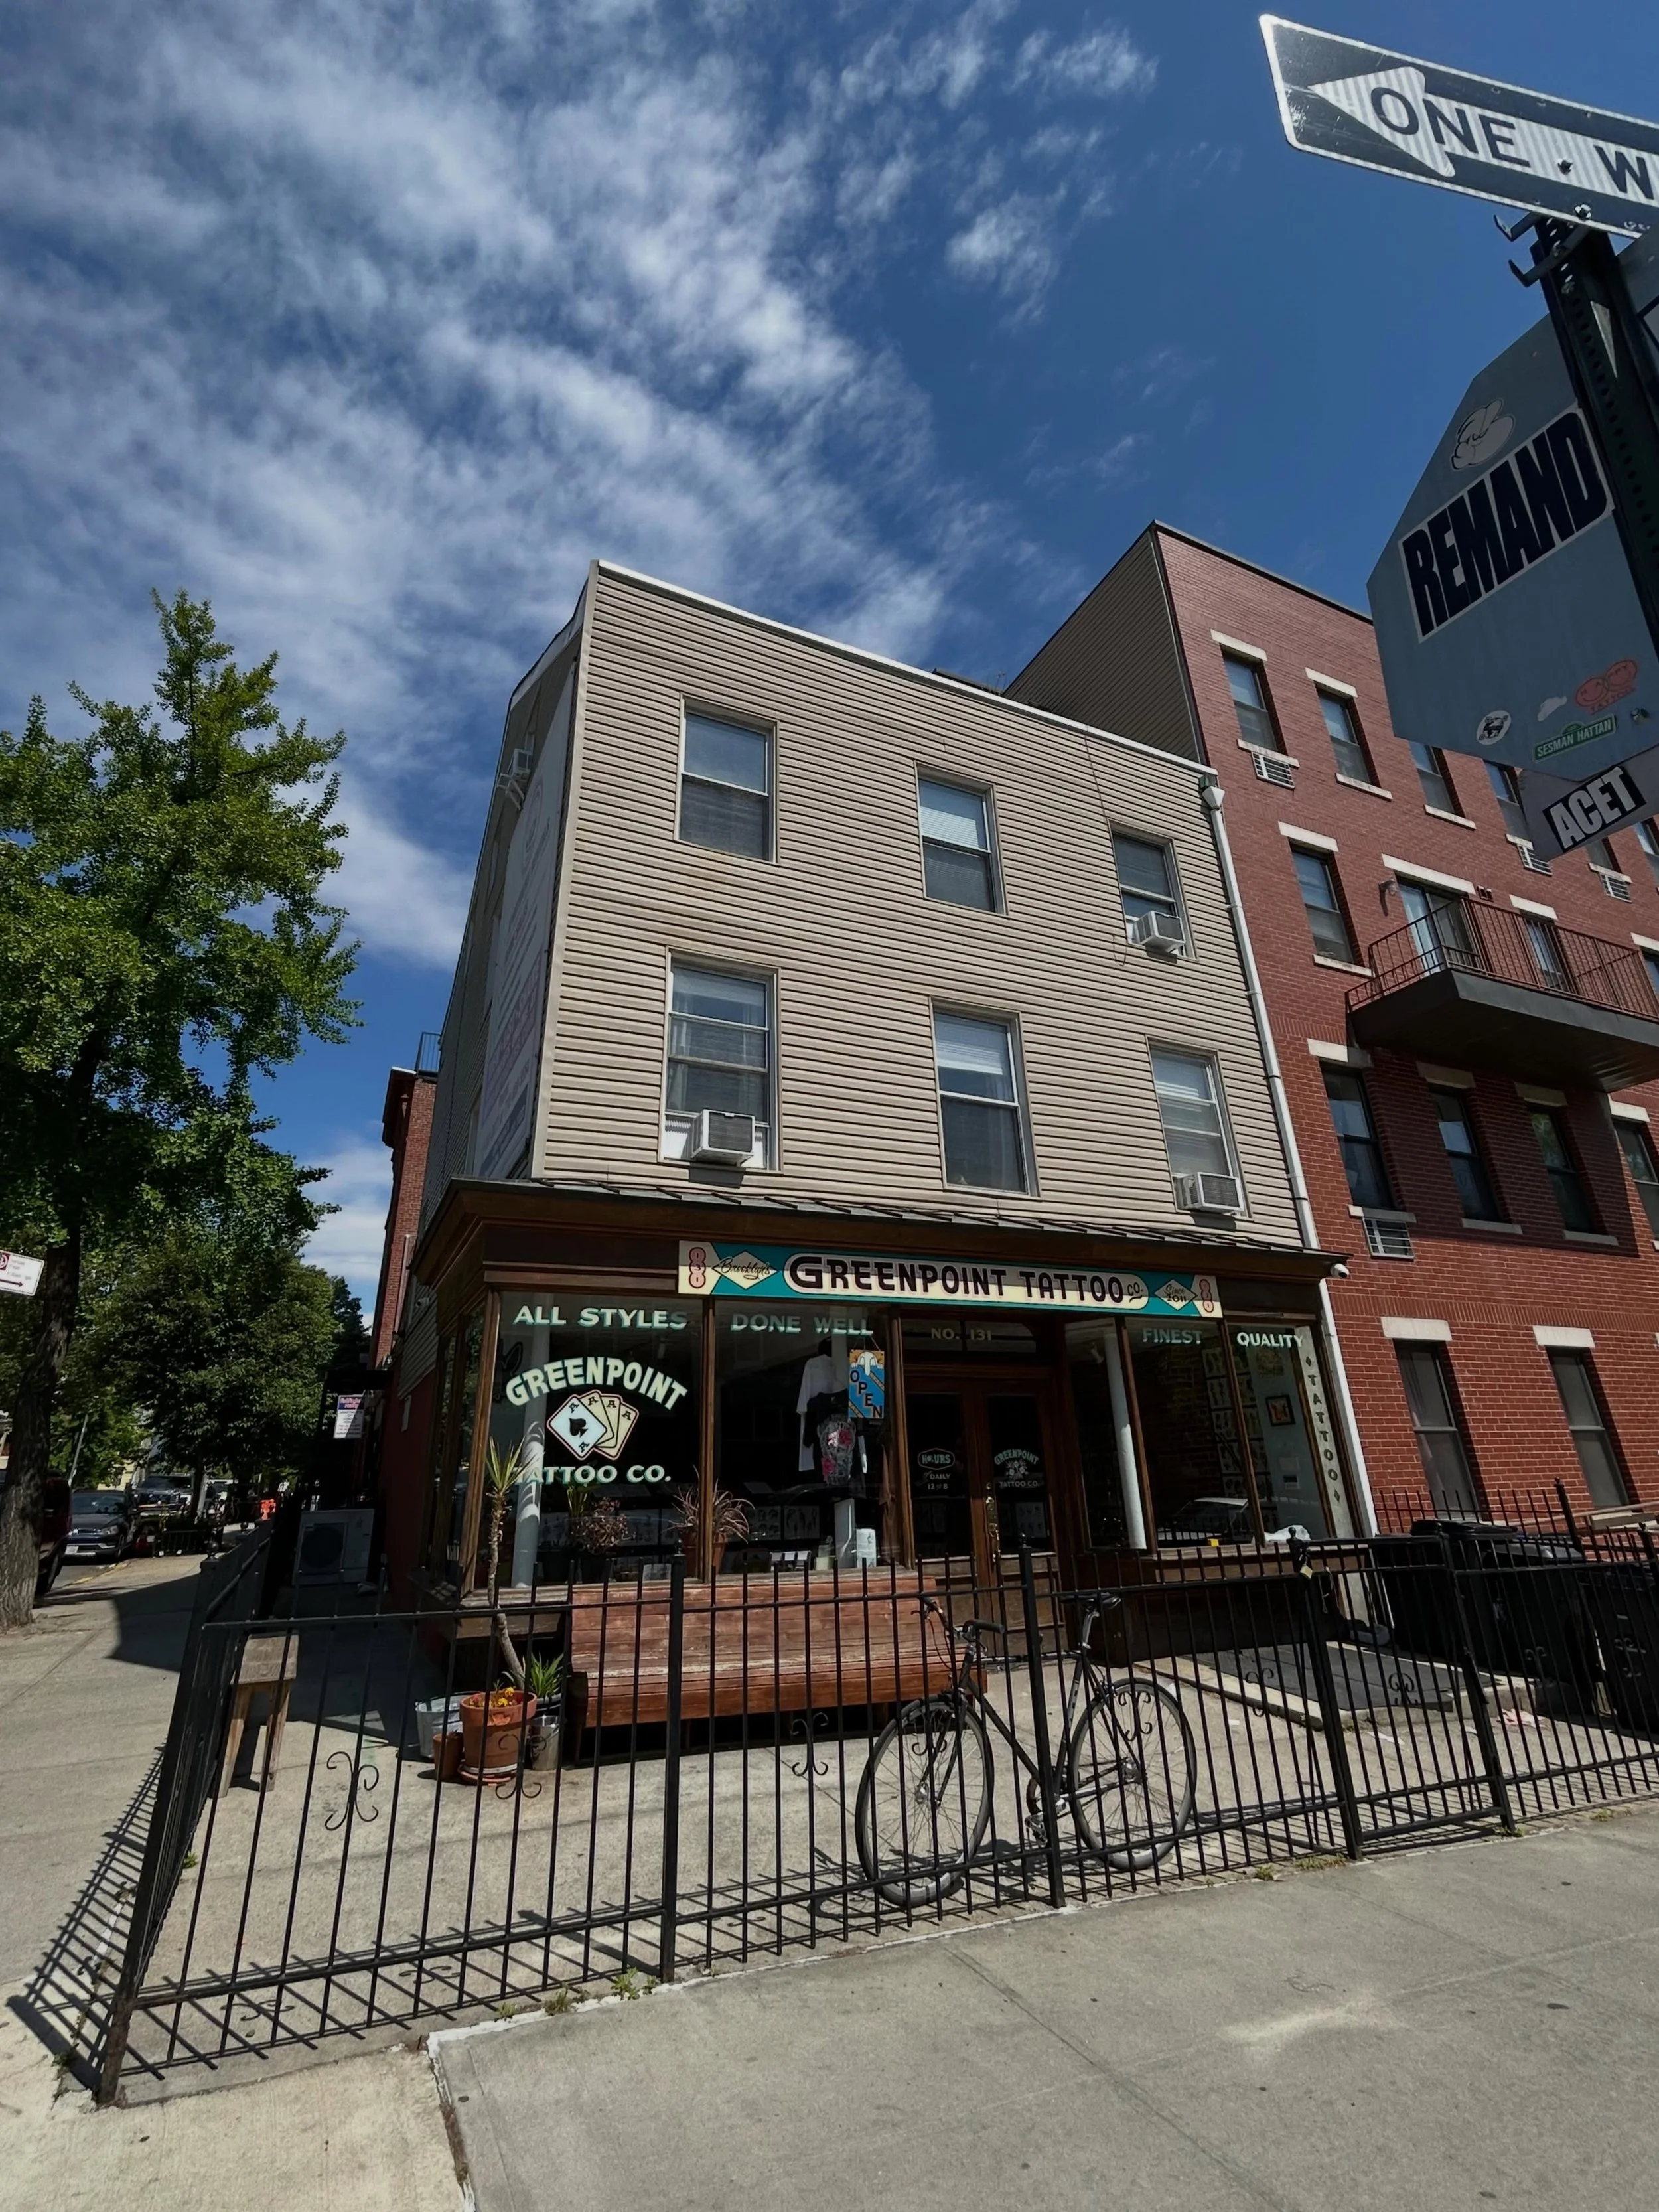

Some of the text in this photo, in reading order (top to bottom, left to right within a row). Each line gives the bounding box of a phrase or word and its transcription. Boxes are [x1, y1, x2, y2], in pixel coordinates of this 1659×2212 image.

[1370, 87, 1532, 168] ONE
[1402, 411, 1608, 637] REMAND
[1537, 719, 1611, 757] SESMAN HATTAN
[1550, 766, 1637, 850] ACET
[719, 1256, 770, 1280] Brooklyn's
[789, 1256, 1143, 1303] GREENPOINT TATTOO CO.
[1167, 1293, 1187, 1302] 2011
[512, 1305, 687, 1331] ALL STYLES
[730, 1313, 874, 1336] DONE WELL
[930, 1327, 992, 1341] NO. 131
[1142, 1327, 1202, 1345] FINEST
[1236, 1331, 1304, 1348] QUALITY
[506, 1356, 688, 1411] GREENPOINT
[850, 1370, 883, 1418] OPEN
[1307, 1374, 1338, 1481] TATTOO
[994, 1449, 1040, 1465] GREENPOINT
[626, 1464, 672, 1484] CO.
